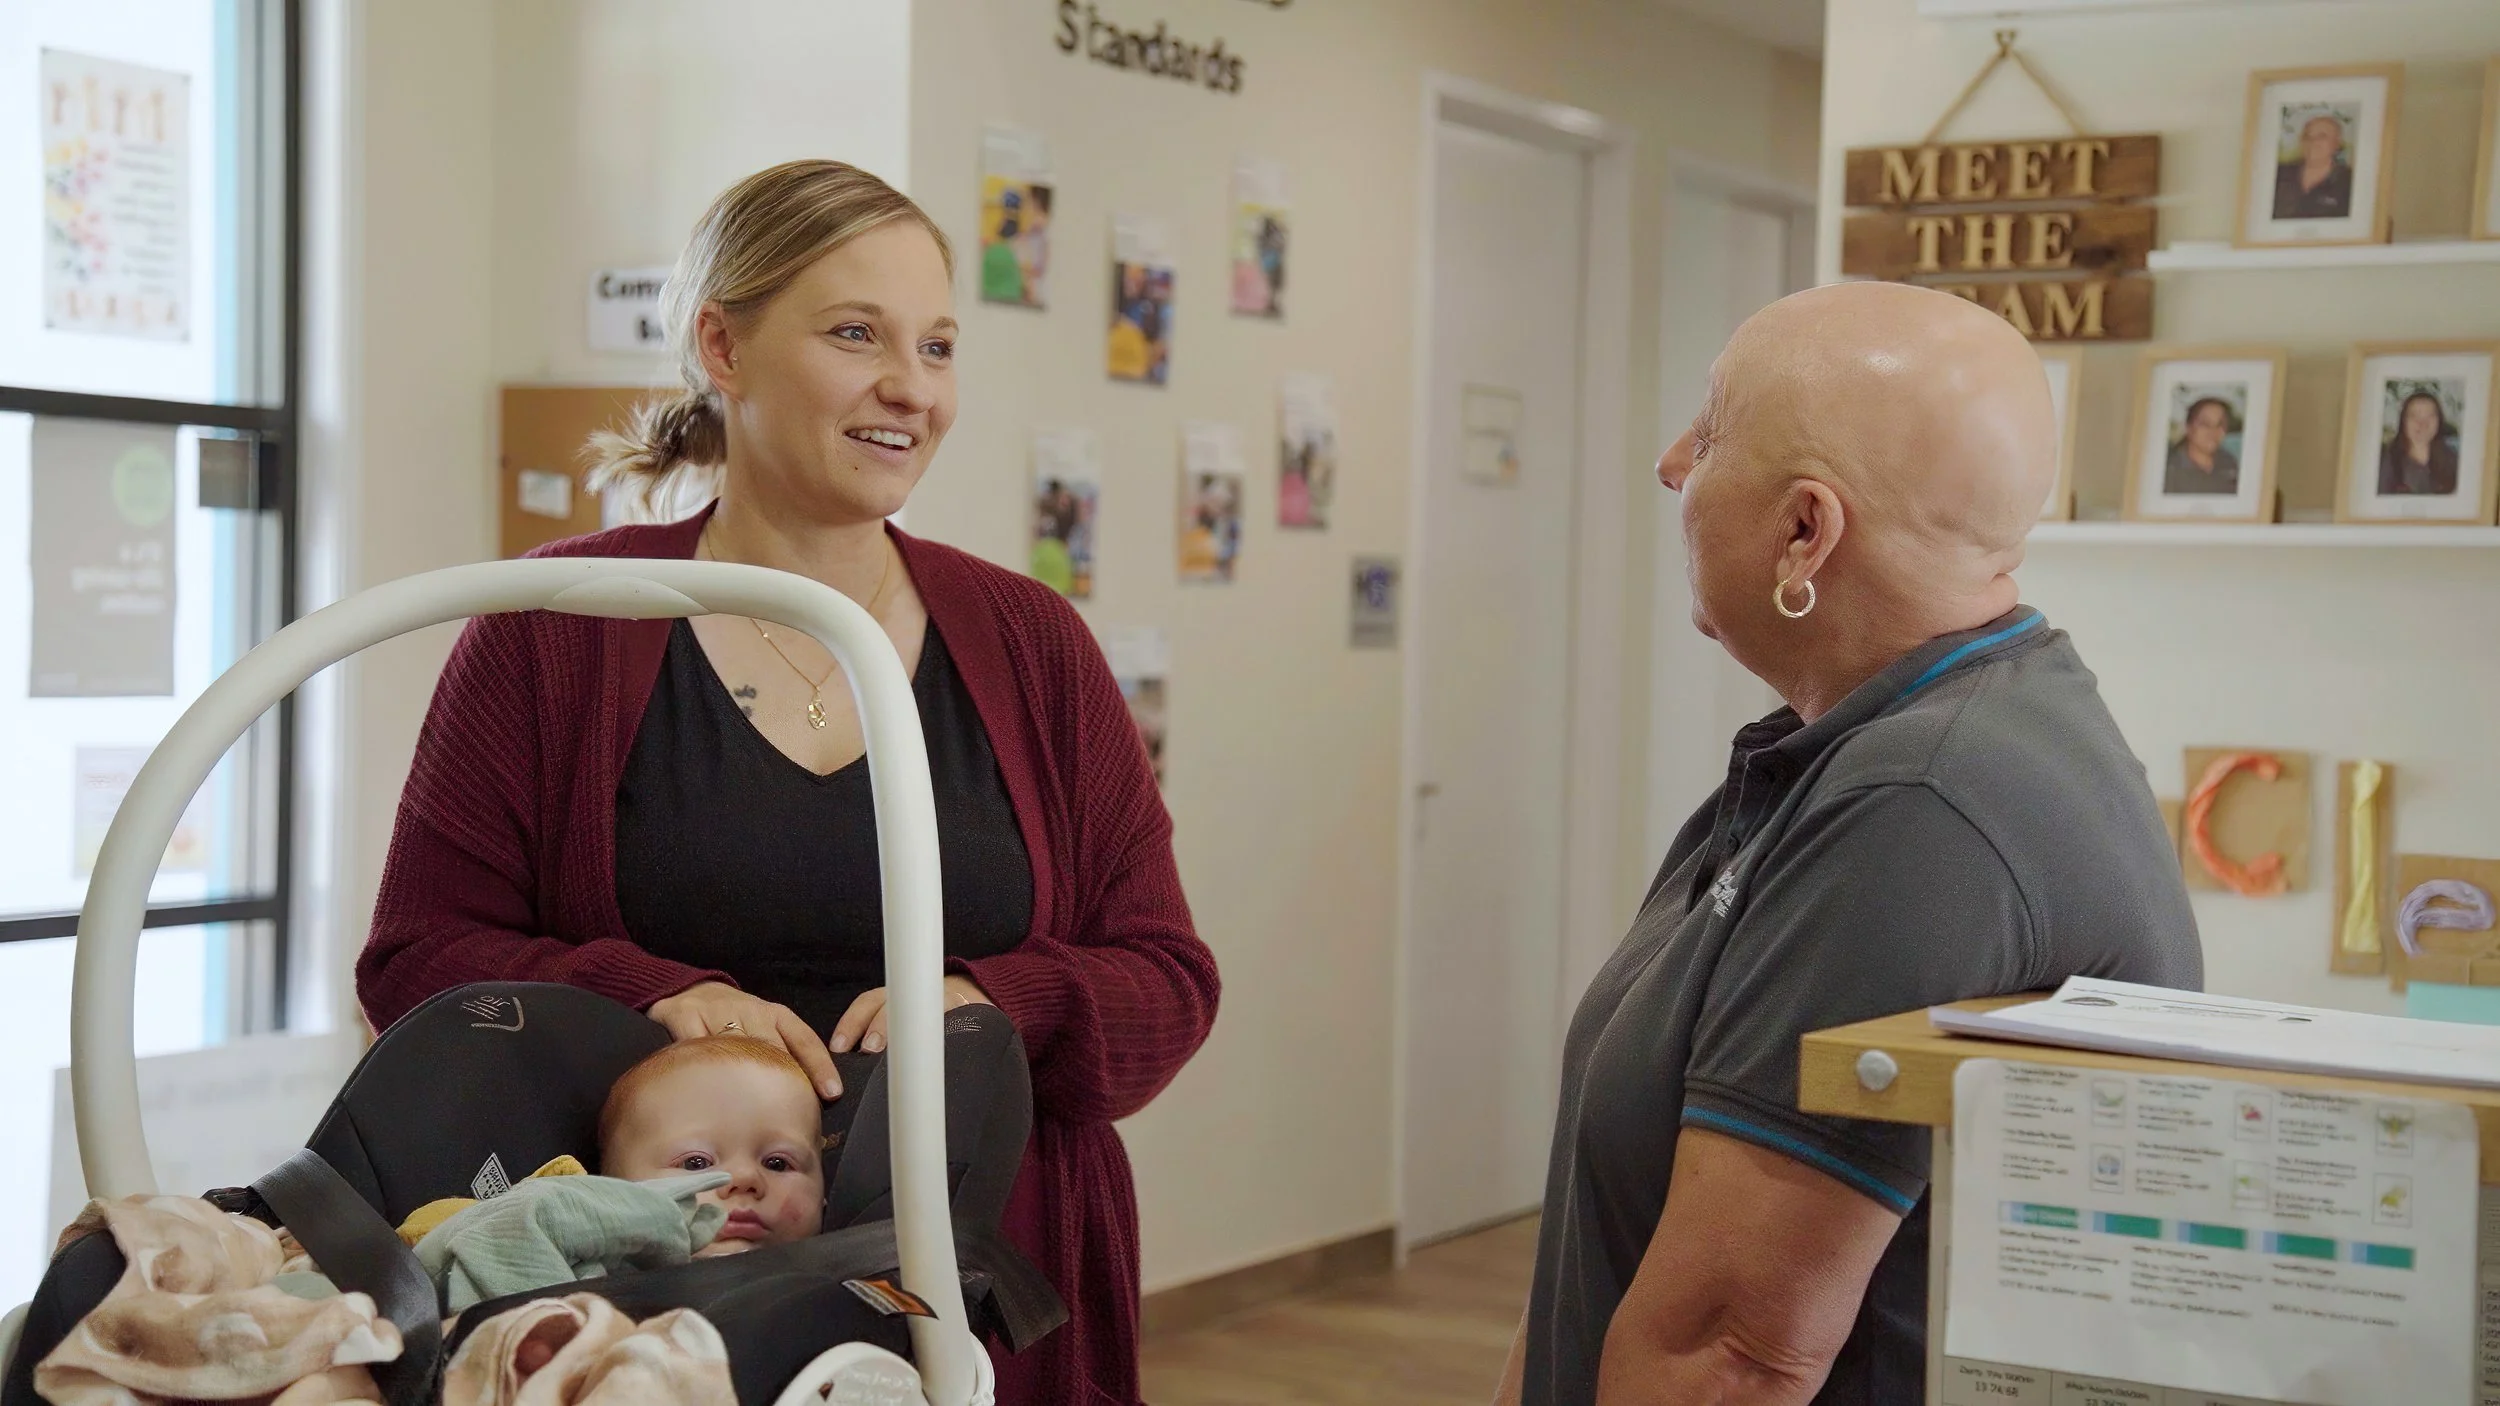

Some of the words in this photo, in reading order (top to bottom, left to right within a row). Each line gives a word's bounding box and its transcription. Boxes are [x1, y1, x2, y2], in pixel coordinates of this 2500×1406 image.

[1054, 0, 1246, 95] Standards
[1878, 140, 2110, 201] MEET
[1906, 212, 2074, 272] THE
[1938, 282, 2107, 338] AM
